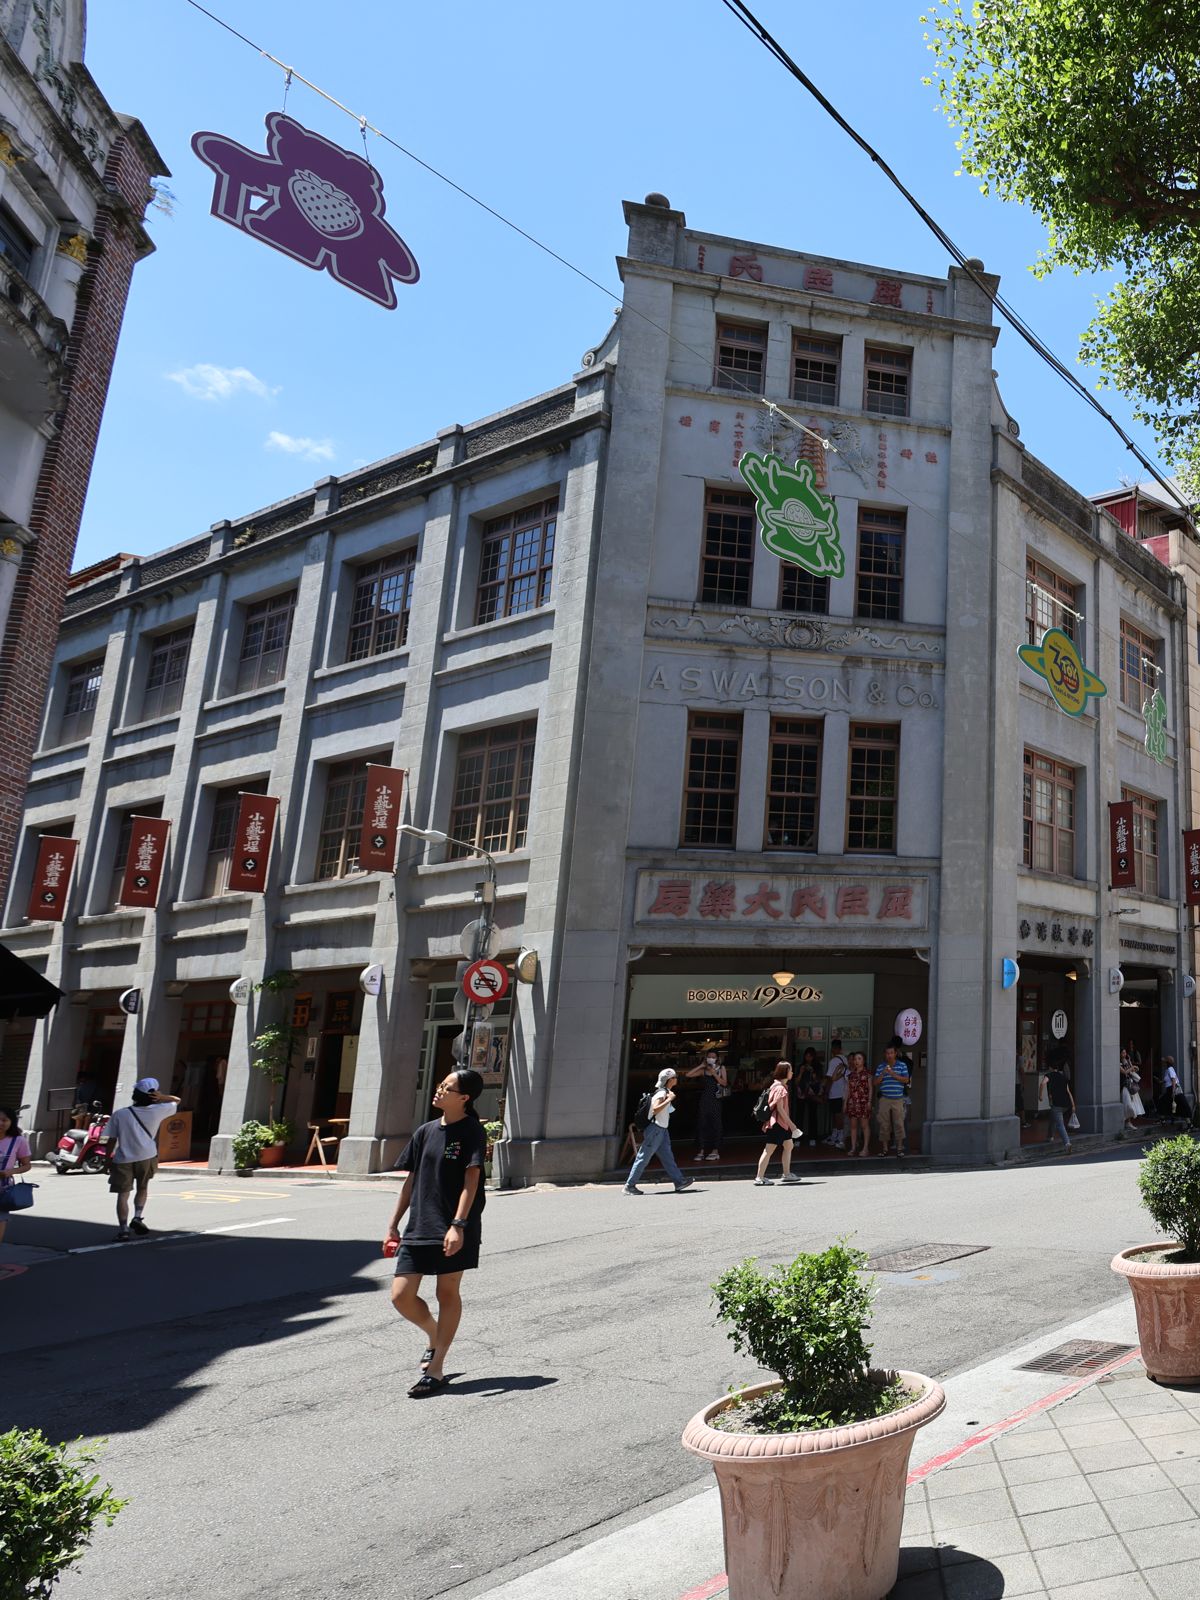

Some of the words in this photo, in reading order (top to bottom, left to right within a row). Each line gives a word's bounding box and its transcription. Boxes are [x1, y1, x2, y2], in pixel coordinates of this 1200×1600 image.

[866, 681, 888, 705] &
[371, 785, 393, 829] 小藝埕
[243, 812, 265, 853] 小藝埕
[1115, 816, 1129, 854] 小藝埕
[43, 852, 64, 888] 小藝埕
[135, 833, 157, 871] 小藝埕
[687, 989, 748, 1002] BOOKBAR
[752, 985, 823, 1009] 1920s
